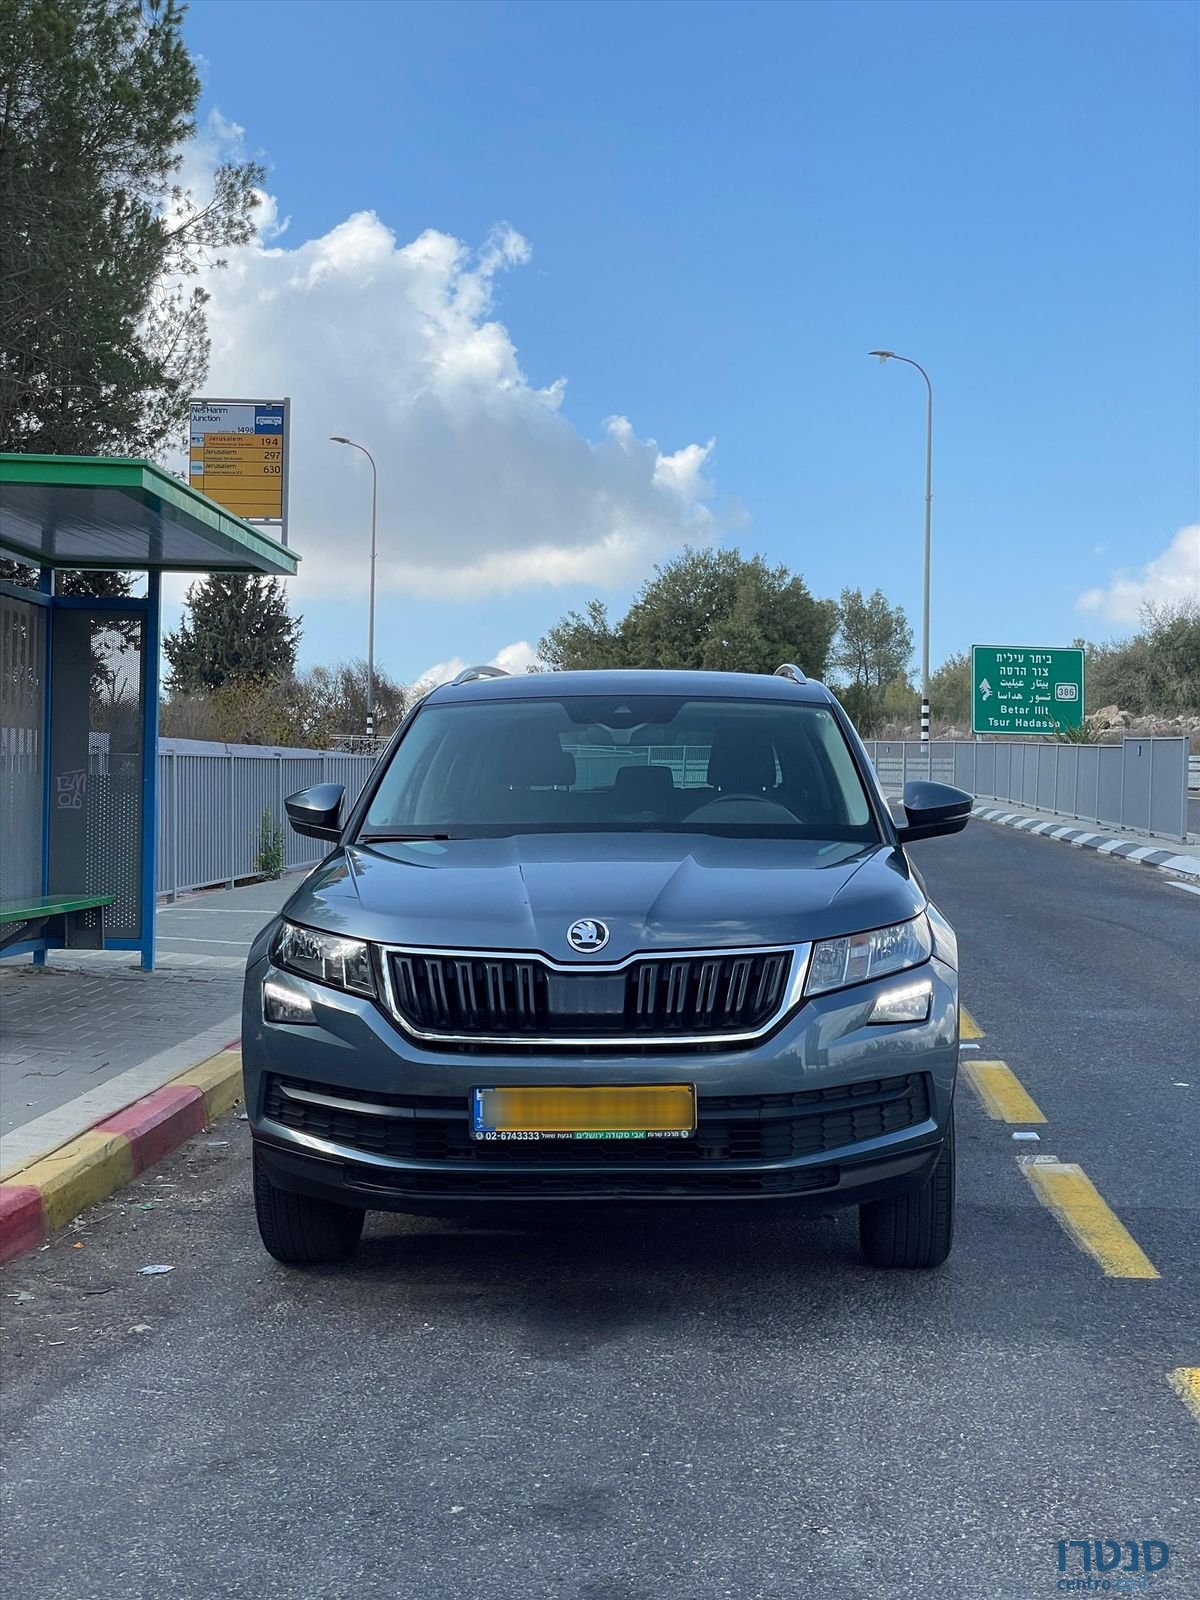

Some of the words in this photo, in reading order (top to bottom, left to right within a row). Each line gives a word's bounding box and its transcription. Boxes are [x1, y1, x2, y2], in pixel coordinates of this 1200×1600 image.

[261, 438, 278, 446] 194
[264, 452, 280, 460] 297
[264, 466, 280, 474] 630
[996, 653, 1024, 662] עילית
[1030, 654, 1052, 664] ביתר
[1000, 666, 1026, 676] הדסה
[1032, 668, 1049, 676] צור
[998, 692, 1022, 700] هداسا
[1058, 688, 1074, 696] 386
[1000, 706, 1030, 714] Betar
[988, 718, 1010, 726] Tsur
[486, 1132, 540, 1140] 02-6743333
